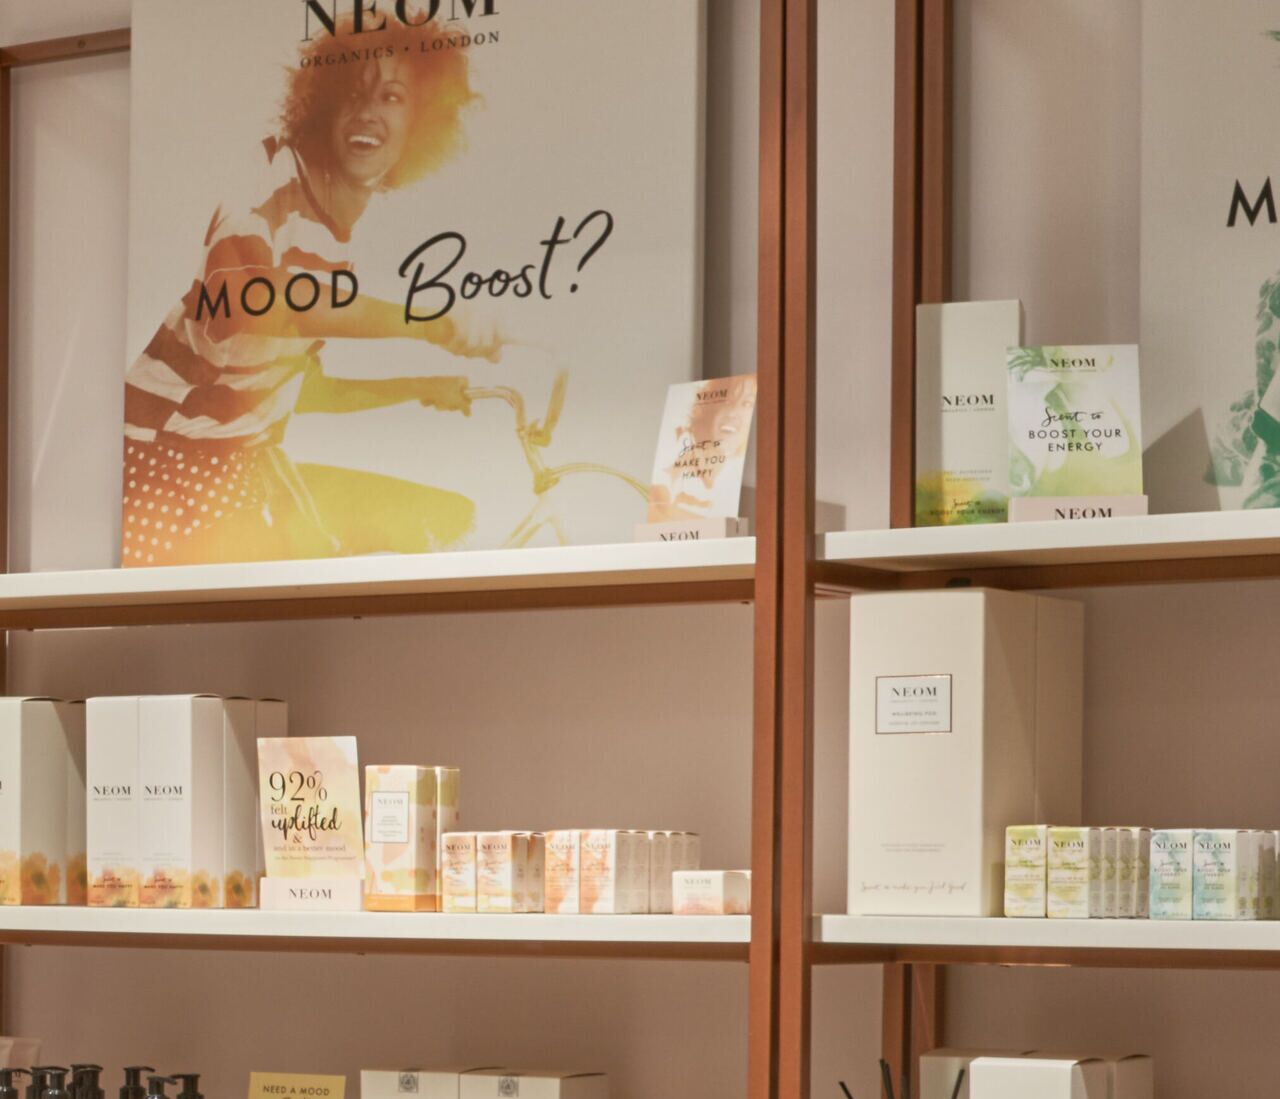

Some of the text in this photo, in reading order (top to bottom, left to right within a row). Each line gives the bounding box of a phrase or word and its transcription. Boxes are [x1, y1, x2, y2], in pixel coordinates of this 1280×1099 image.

[300, 31, 500, 68] ORGANICS LONDON
[195, 209, 614, 324] MOOD Boost?
[1049, 358, 1095, 368] NEOM
[942, 394, 994, 406] NEOM
[1029, 428, 1122, 439] BOOST YOUR
[1048, 442, 1103, 452] ENERGY
[674, 455, 726, 468] MAKE YOU
[683, 469, 713, 479] HAPPY
[1055, 507, 1112, 519] NEOM
[269, 770, 328, 802] 92%
[271, 804, 342, 841] uplifted
[263, 1085, 287, 1094] NEED
[299, 1087, 330, 1096] MOOD
